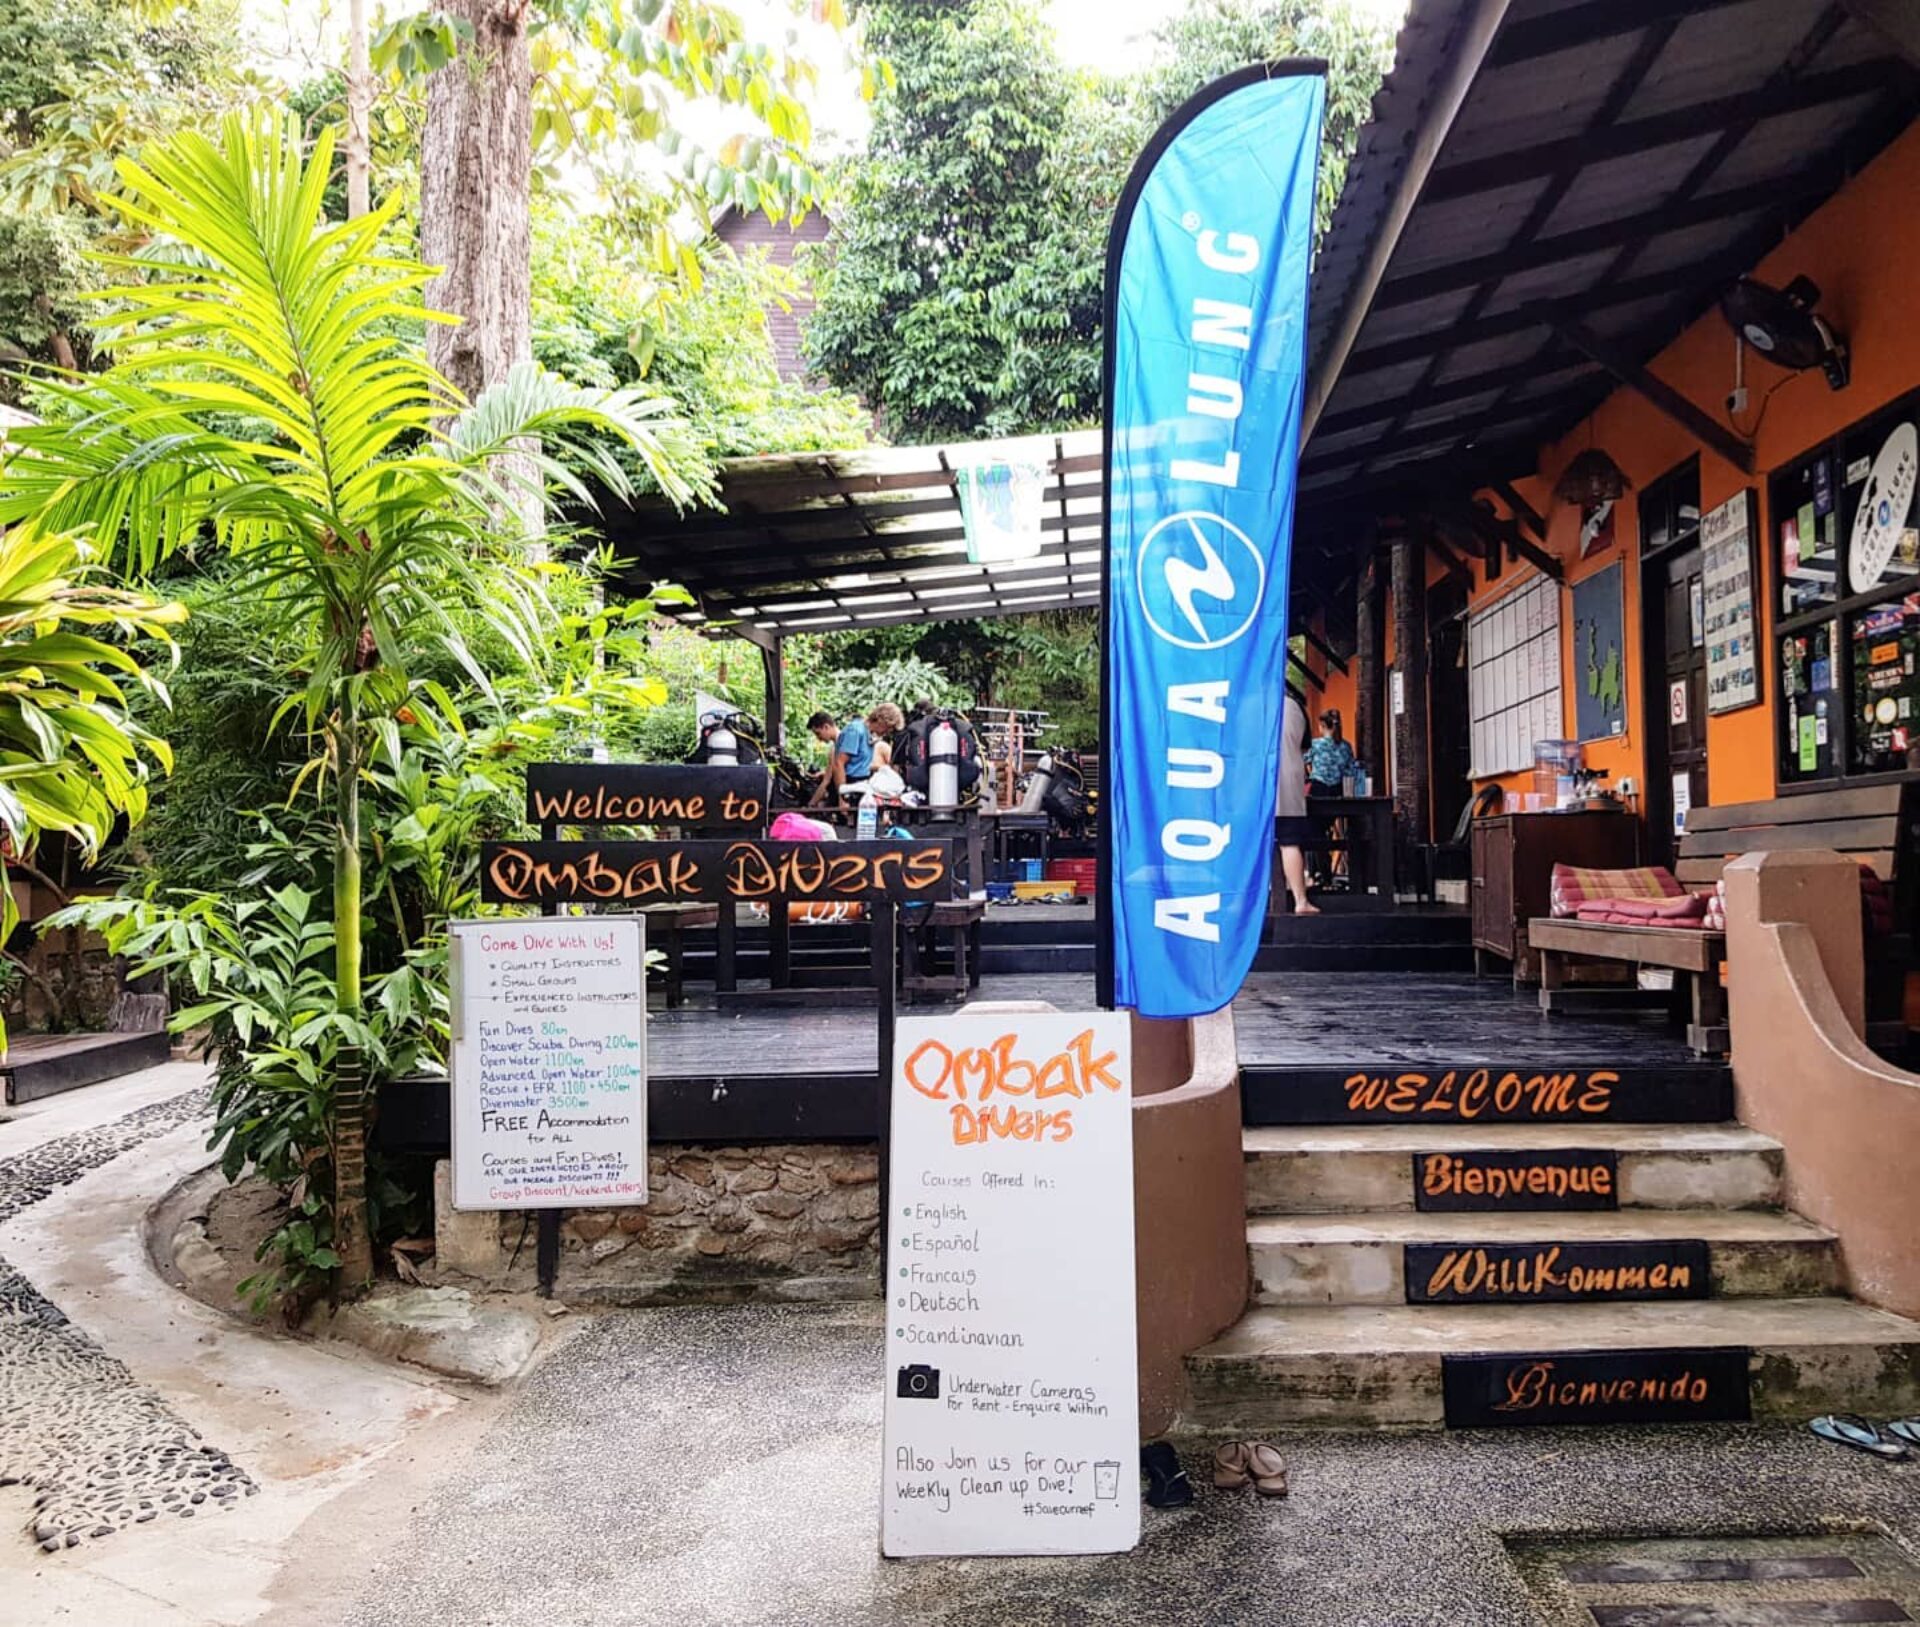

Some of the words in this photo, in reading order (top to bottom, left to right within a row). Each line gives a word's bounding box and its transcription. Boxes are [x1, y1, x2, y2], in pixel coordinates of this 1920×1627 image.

[1169, 229, 1261, 488] LUNG
[535, 786, 705, 821] Welcome
[721, 791, 759, 822] to
[1154, 680, 1231, 943] AQUA
[489, 847, 703, 899] Ombak
[724, 842, 944, 897] Divers
[481, 934, 519, 951] Come
[524, 934, 554, 949] Dive
[479, 1021, 500, 1037] Fun
[506, 1021, 534, 1035] Dives
[481, 1038, 523, 1051] Discover
[528, 1036, 564, 1050] Scuba
[569, 1035, 603, 1054] Diving
[480, 1055, 506, 1068] Open
[481, 1070, 535, 1082] Advanced
[542, 1067, 567, 1082] Open
[481, 1082, 518, 1095] Rescue
[533, 1082, 557, 1094] EFR
[1344, 1069, 1620, 1118] WELCOME
[480, 1097, 542, 1110] Divemaster
[481, 1110, 529, 1132] FREE
[537, 1109, 629, 1130] Accommodation
[528, 1133, 545, 1144] for
[552, 1134, 573, 1144] ALL
[482, 1152, 528, 1167] Courses
[533, 1154, 552, 1164] and
[556, 1151, 579, 1164] Fun
[484, 1167, 504, 1177] ASK
[922, 1170, 971, 1187] Courses
[982, 1171, 1024, 1188] Offered
[1423, 1154, 1611, 1198] Bienvenue
[489, 1187, 521, 1200] Group
[916, 1203, 967, 1229] English
[912, 1228, 979, 1257] Español
[911, 1263, 976, 1285] Francais
[910, 1289, 979, 1313] Deutsch
[906, 1324, 1024, 1347] Scandinavian
[949, 1374, 1023, 1398] Underwater
[1030, 1379, 1096, 1401] Cameras
[1491, 1362, 1707, 1411] Bienvenido
[972, 1397, 1000, 1412] Rent
[897, 1446, 934, 1472] Also
[944, 1447, 977, 1471] Join
[988, 1457, 1010, 1472] us
[960, 1477, 1002, 1496] Clean
[1009, 1479, 1029, 1502] up
